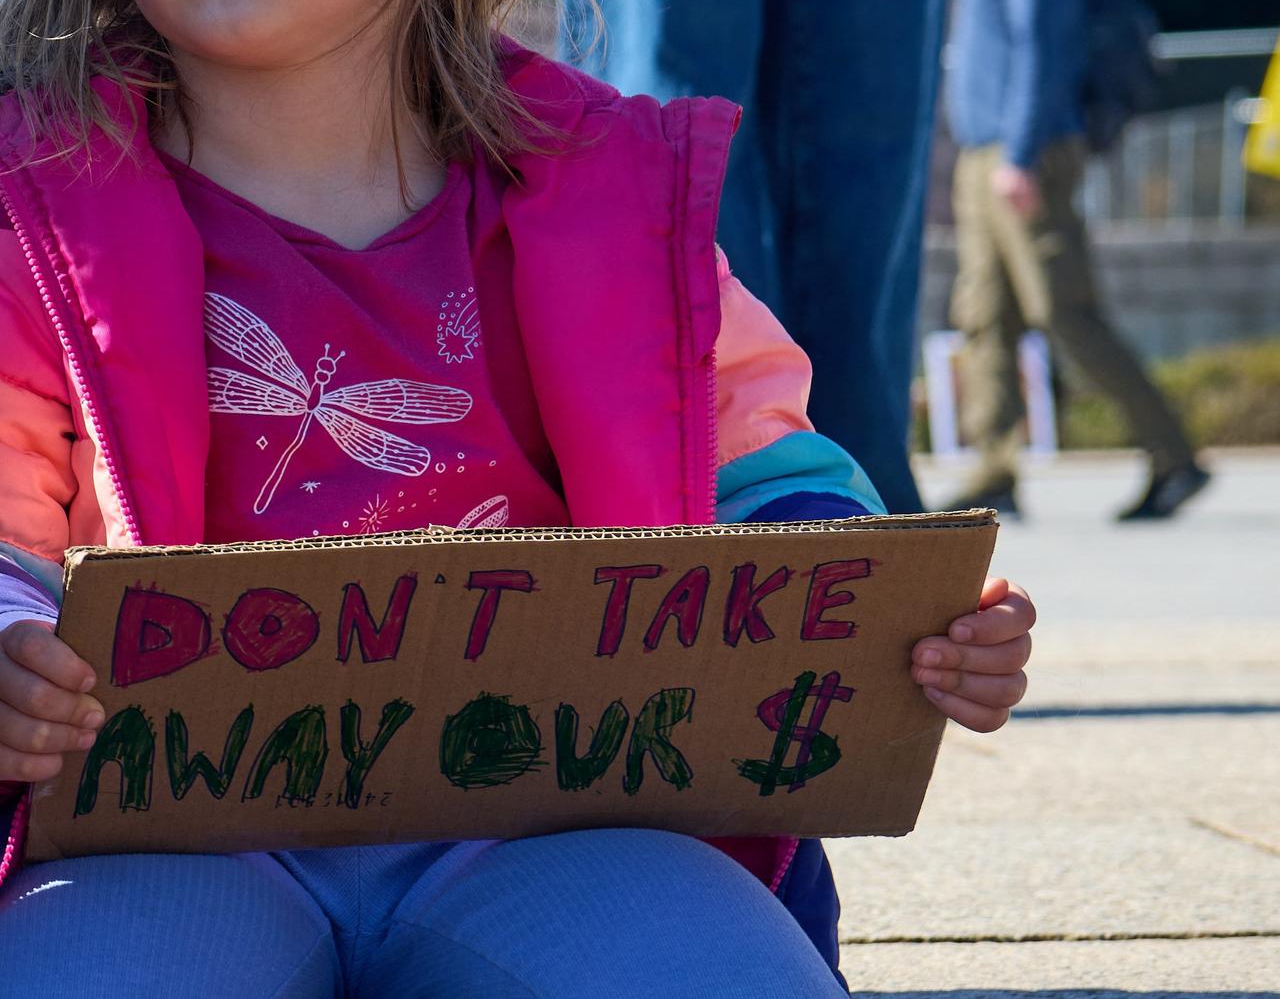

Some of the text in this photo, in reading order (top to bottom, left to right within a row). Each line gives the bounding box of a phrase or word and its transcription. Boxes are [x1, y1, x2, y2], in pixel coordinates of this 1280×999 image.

[109, 558, 872, 688] DON'T TAKE
[74, 669, 854, 819] AWAY OUR $
